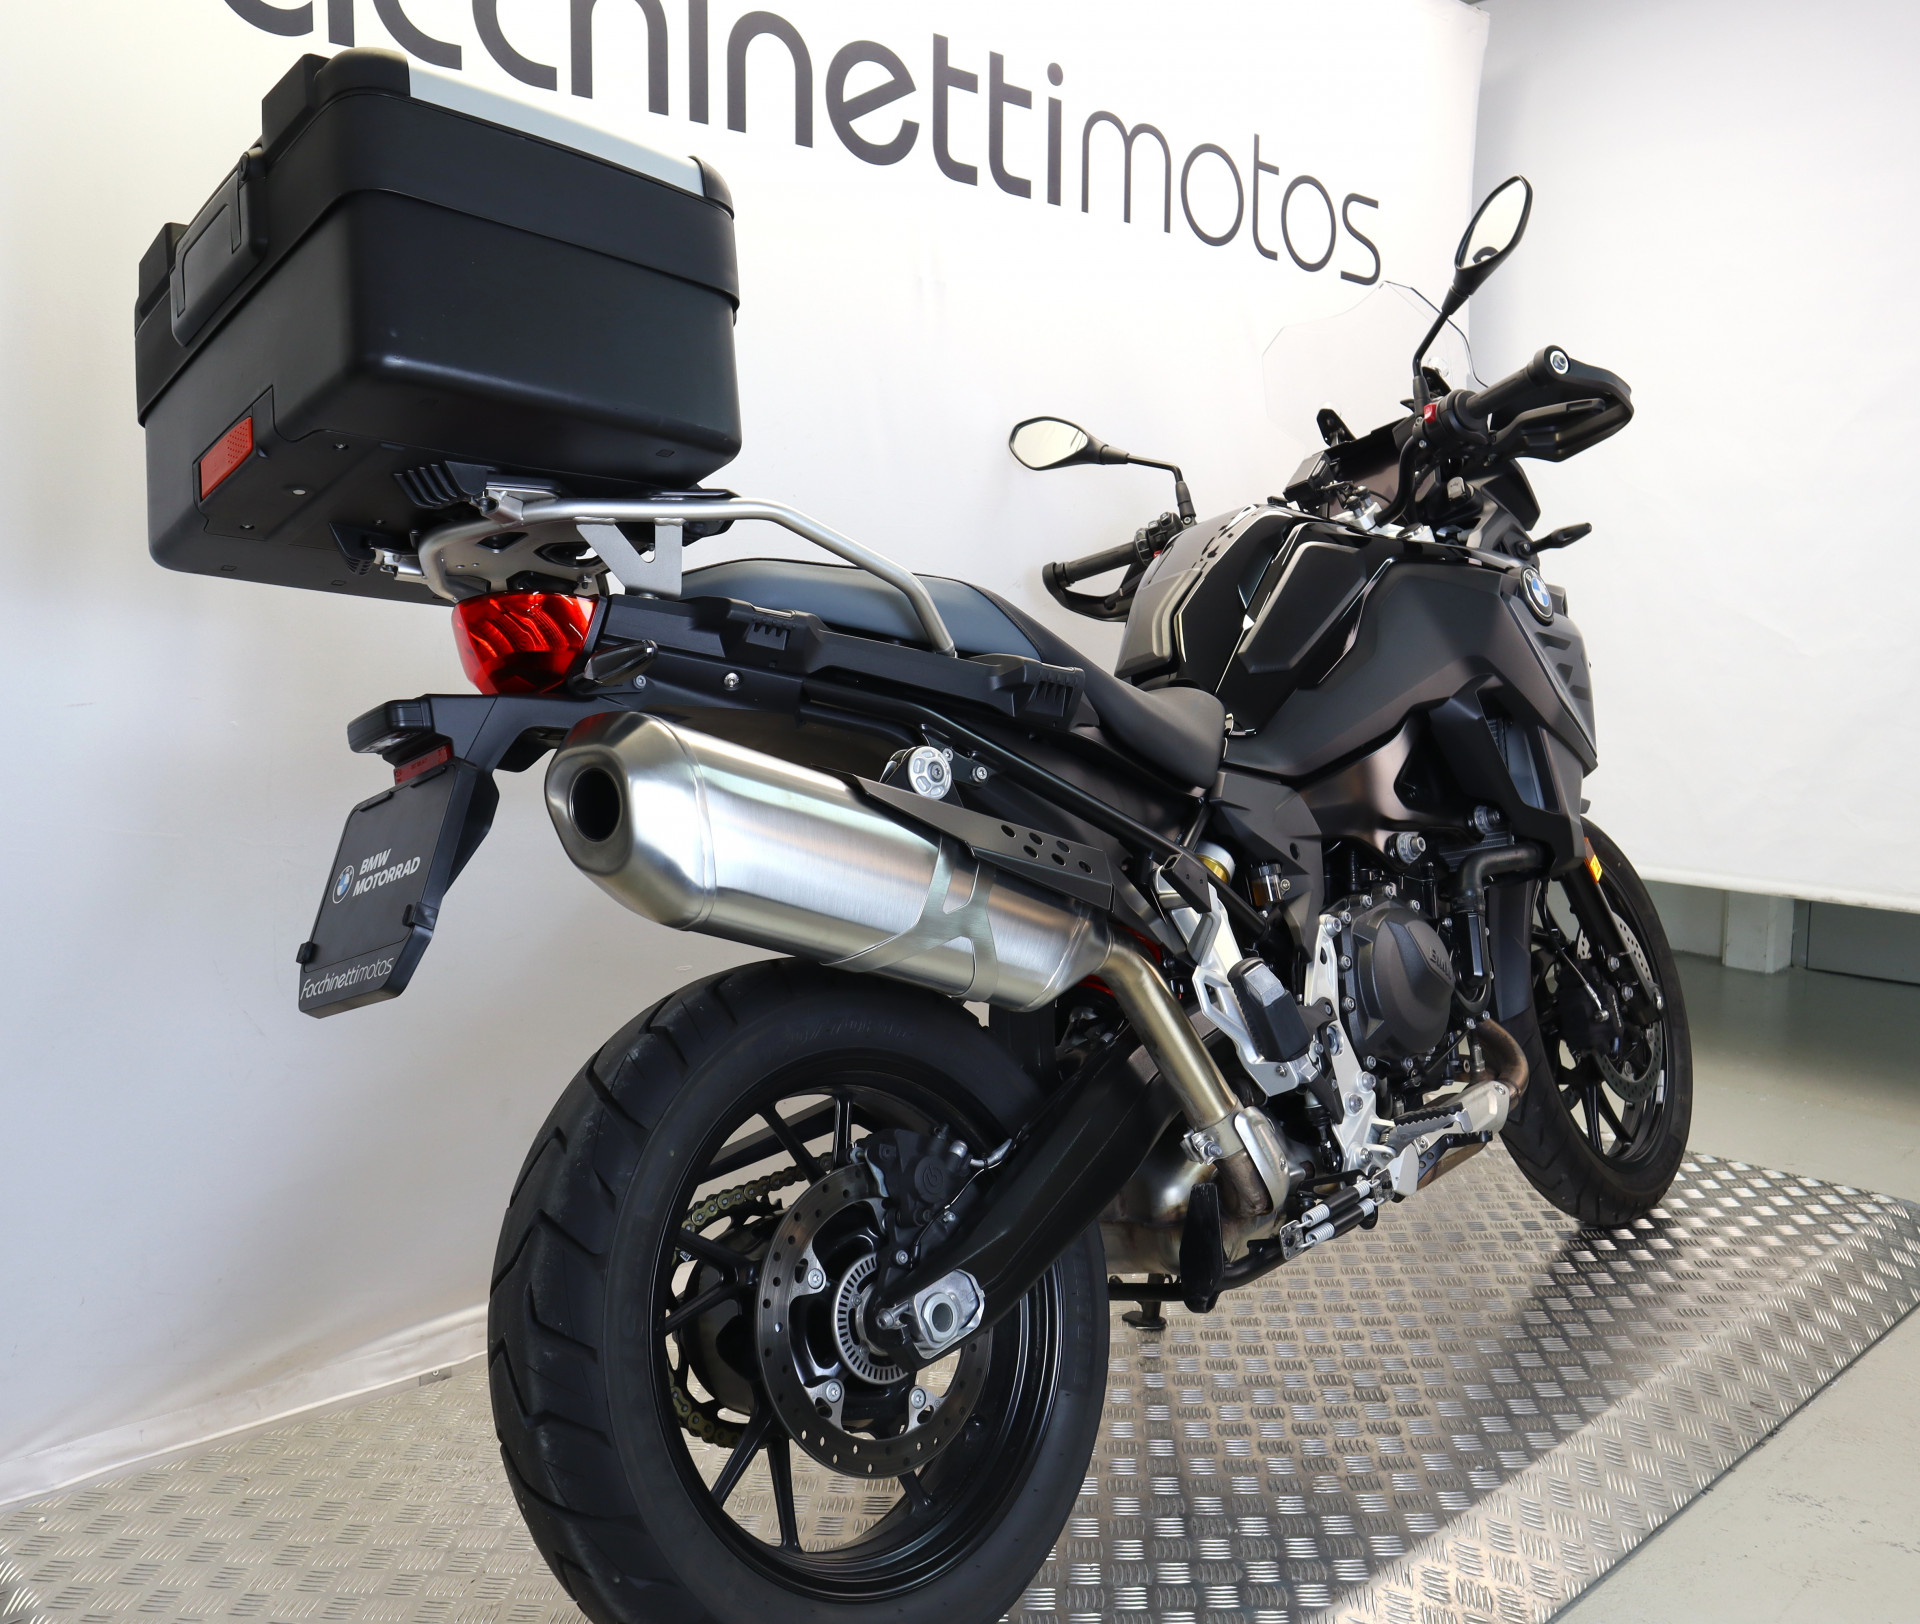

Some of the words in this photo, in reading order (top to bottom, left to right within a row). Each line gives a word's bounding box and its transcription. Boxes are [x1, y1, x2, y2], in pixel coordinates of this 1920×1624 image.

[352, 856, 421, 897] MOTORRAD
[359, 848, 392, 876] BMW
[300, 957, 394, 1001] facchinettimotos
